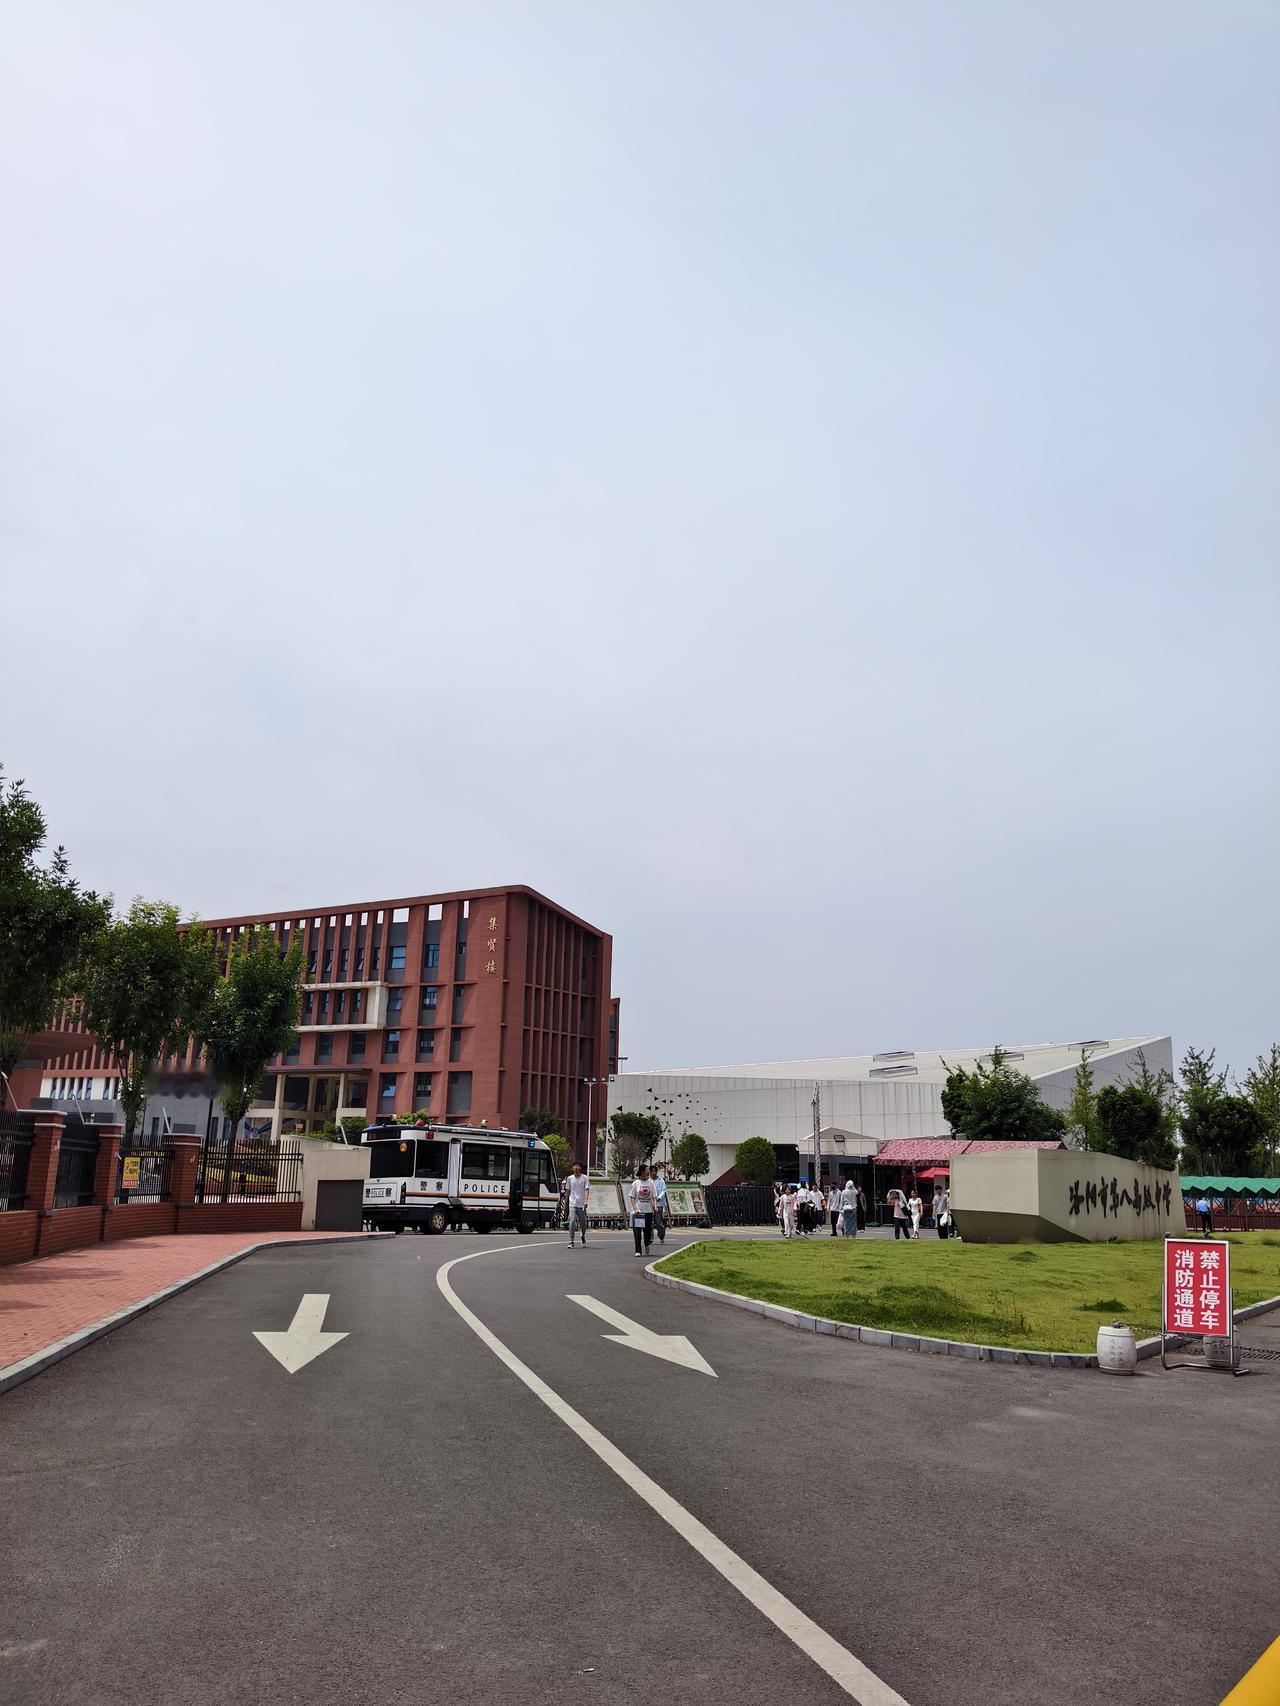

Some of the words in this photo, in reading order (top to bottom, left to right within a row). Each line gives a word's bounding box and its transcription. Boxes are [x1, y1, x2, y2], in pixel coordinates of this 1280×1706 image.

[420, 1180, 444, 1192] 警察
[464, 1183, 506, 1194] POLICE
[1173, 1249, 1195, 1328] 消防通道
[1199, 1250, 1221, 1329] 禁止停车
